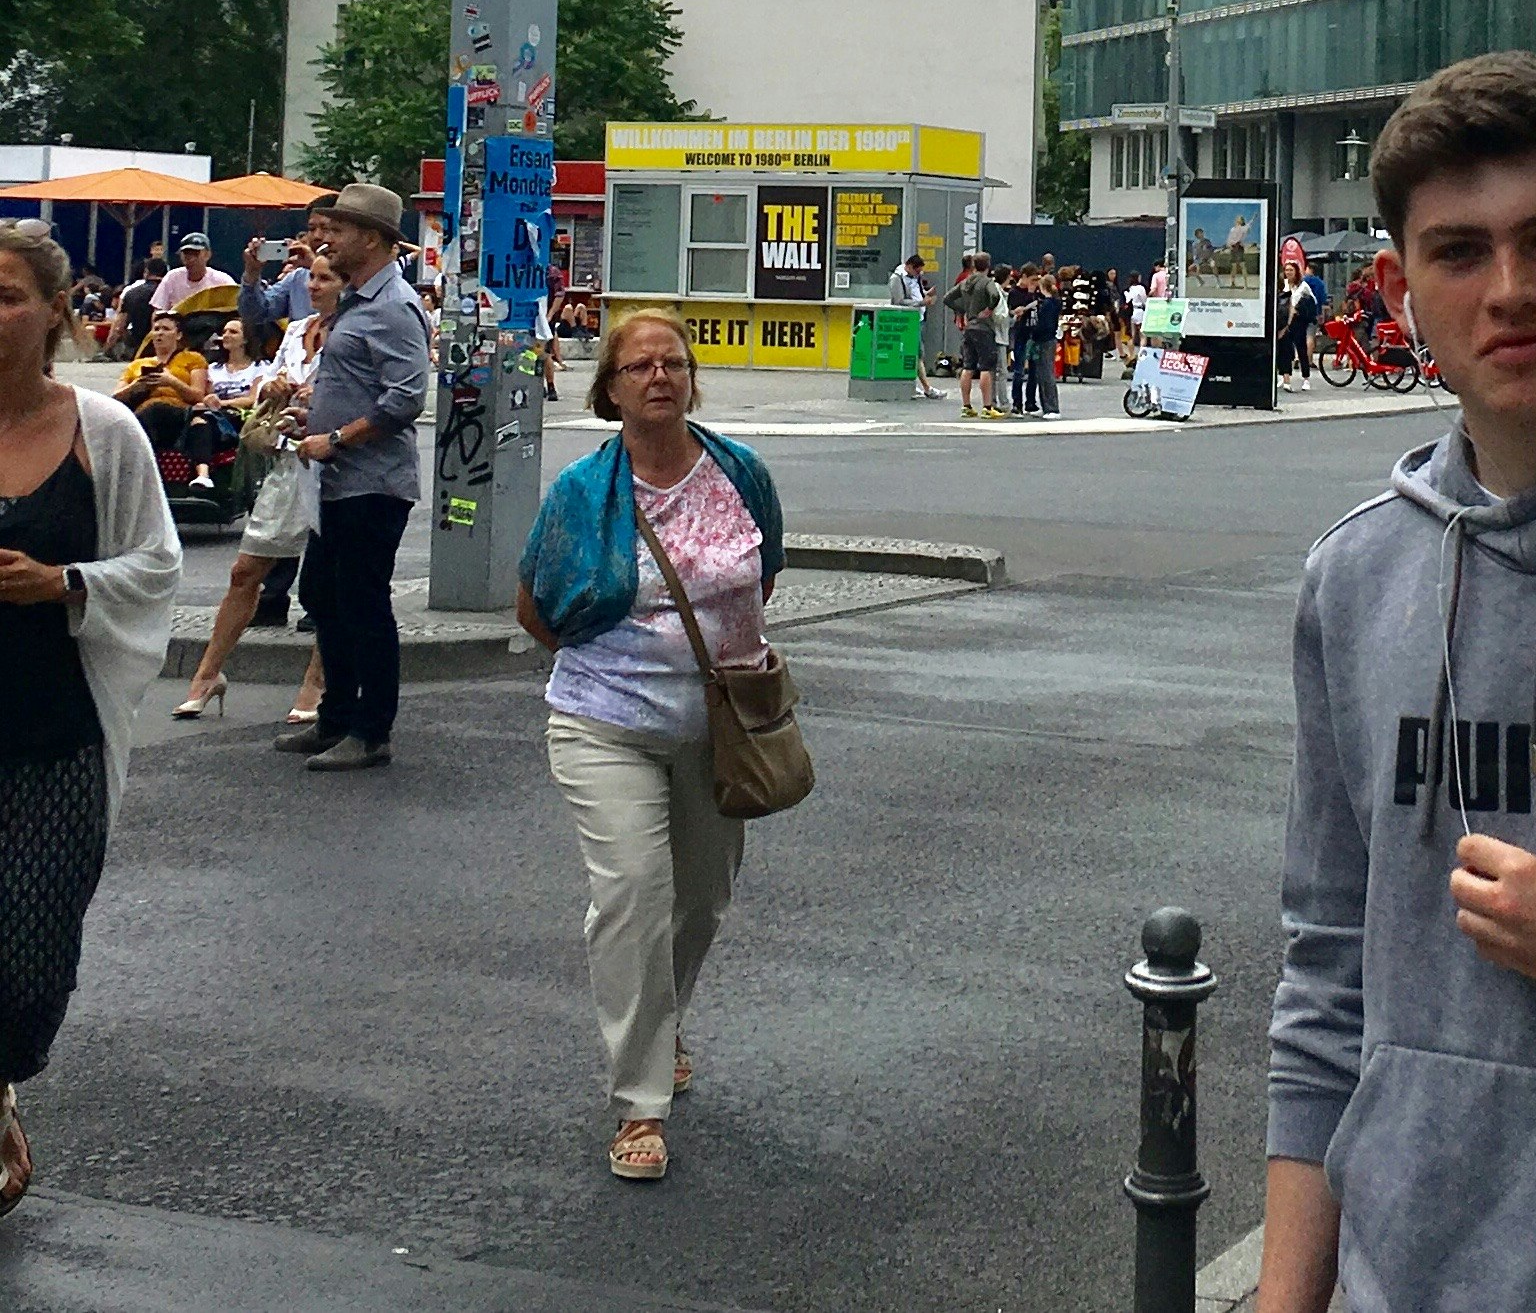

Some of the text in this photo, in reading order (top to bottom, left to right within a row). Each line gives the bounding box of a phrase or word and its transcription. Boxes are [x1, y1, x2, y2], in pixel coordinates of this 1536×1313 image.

[753, 129, 812, 151] BERLIN
[817, 130, 849, 151] DER
[510, 144, 551, 170] Ersan
[685, 152, 736, 166] WELCOME
[738, 153, 752, 166] TO
[793, 153, 830, 167] BERLIN
[489, 170, 552, 197] Mondta
[763, 204, 820, 242] THE
[761, 241, 822, 270] WALL
[485, 253, 545, 289] Livin
[684, 318, 816, 349] SEE IT HERE
